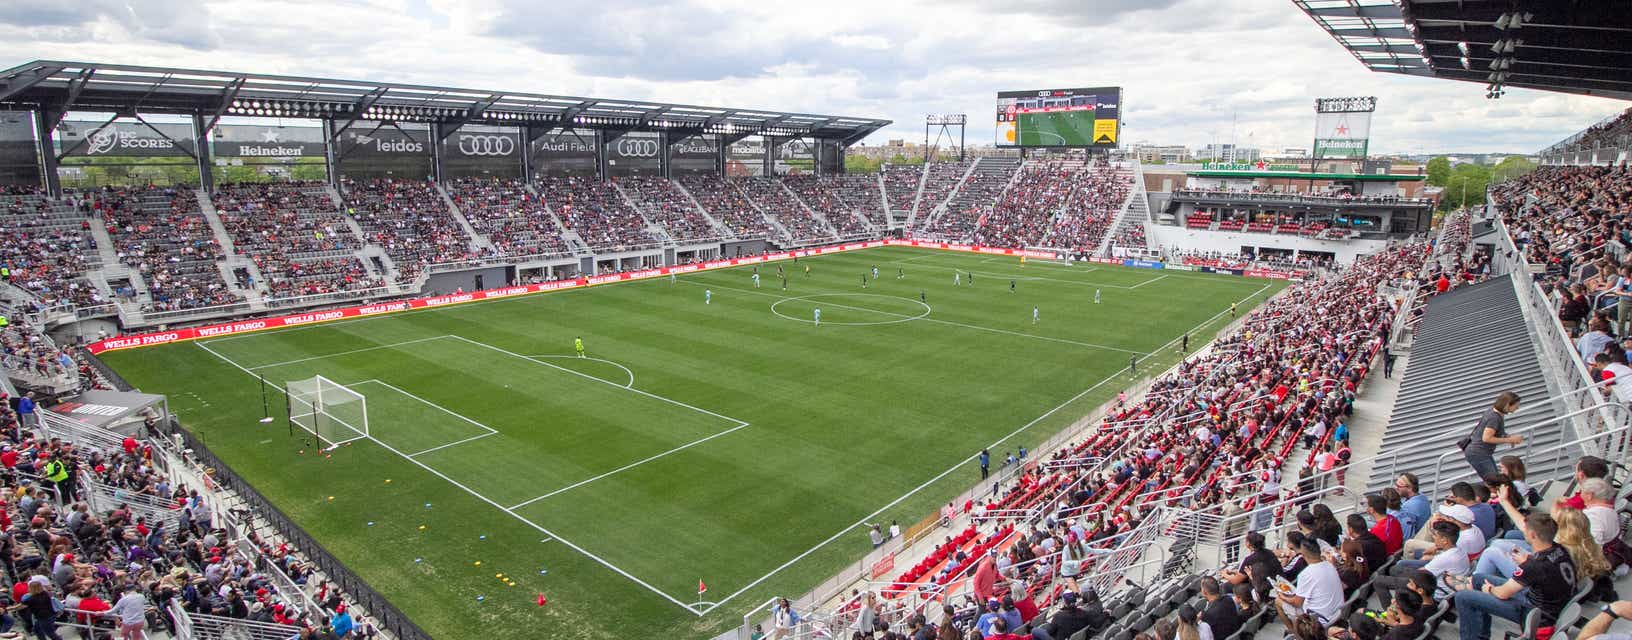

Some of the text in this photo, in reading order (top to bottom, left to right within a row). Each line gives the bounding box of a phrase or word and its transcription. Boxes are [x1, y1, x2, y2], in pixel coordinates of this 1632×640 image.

[119, 130, 137, 139] DC
[120, 139, 173, 148] SCORES
[376, 138, 423, 152] leidos
[541, 141, 595, 151] Audi Field
[1319, 140, 1364, 149] Heineken
[240, 145, 301, 156] Heineken
[1202, 162, 1250, 171] Heineken
[485, 287, 528, 298] WELLS FARGO
[426, 294, 473, 306] WELLS FARGO
[359, 302, 412, 315] WELLS FARG
[284, 311, 344, 325] WELLS FARGO
[198, 321, 266, 337] WELLS FARGO
[103, 338, 141, 349] WELLS
[142, 333, 178, 344] FARGO
